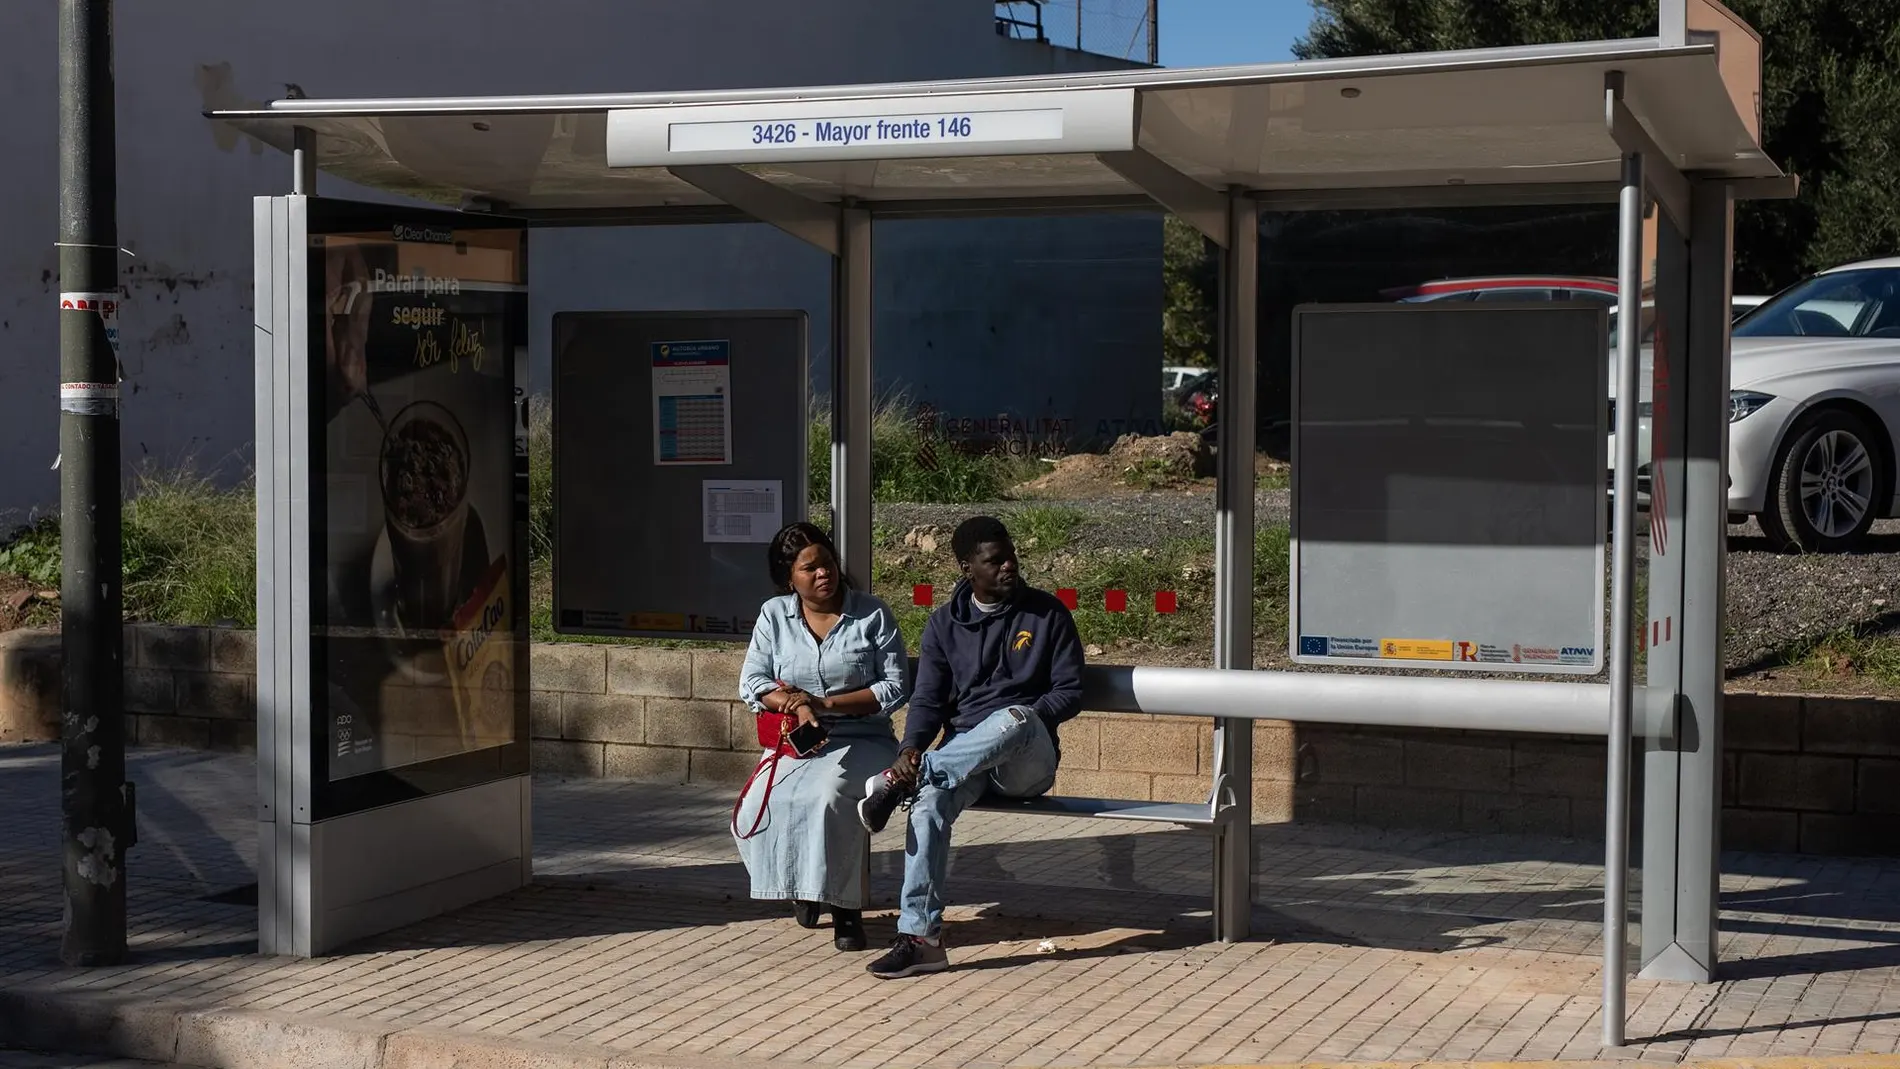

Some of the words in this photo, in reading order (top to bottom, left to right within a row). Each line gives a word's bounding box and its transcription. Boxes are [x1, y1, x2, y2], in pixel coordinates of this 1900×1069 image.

[752, 122, 796, 144] 3426
[815, 121, 871, 145] Mayor
[876, 118, 930, 140] frente
[937, 117, 971, 138] 146
[404, 226, 424, 241] Clear
[374, 268, 418, 293] Parar
[424, 275, 460, 298] para
[391, 302, 445, 330] seguir
[945, 417, 1073, 434] GENERALITAT
[456, 596, 504, 671] ColaCao
[1560, 647, 1594, 656] ATMV
